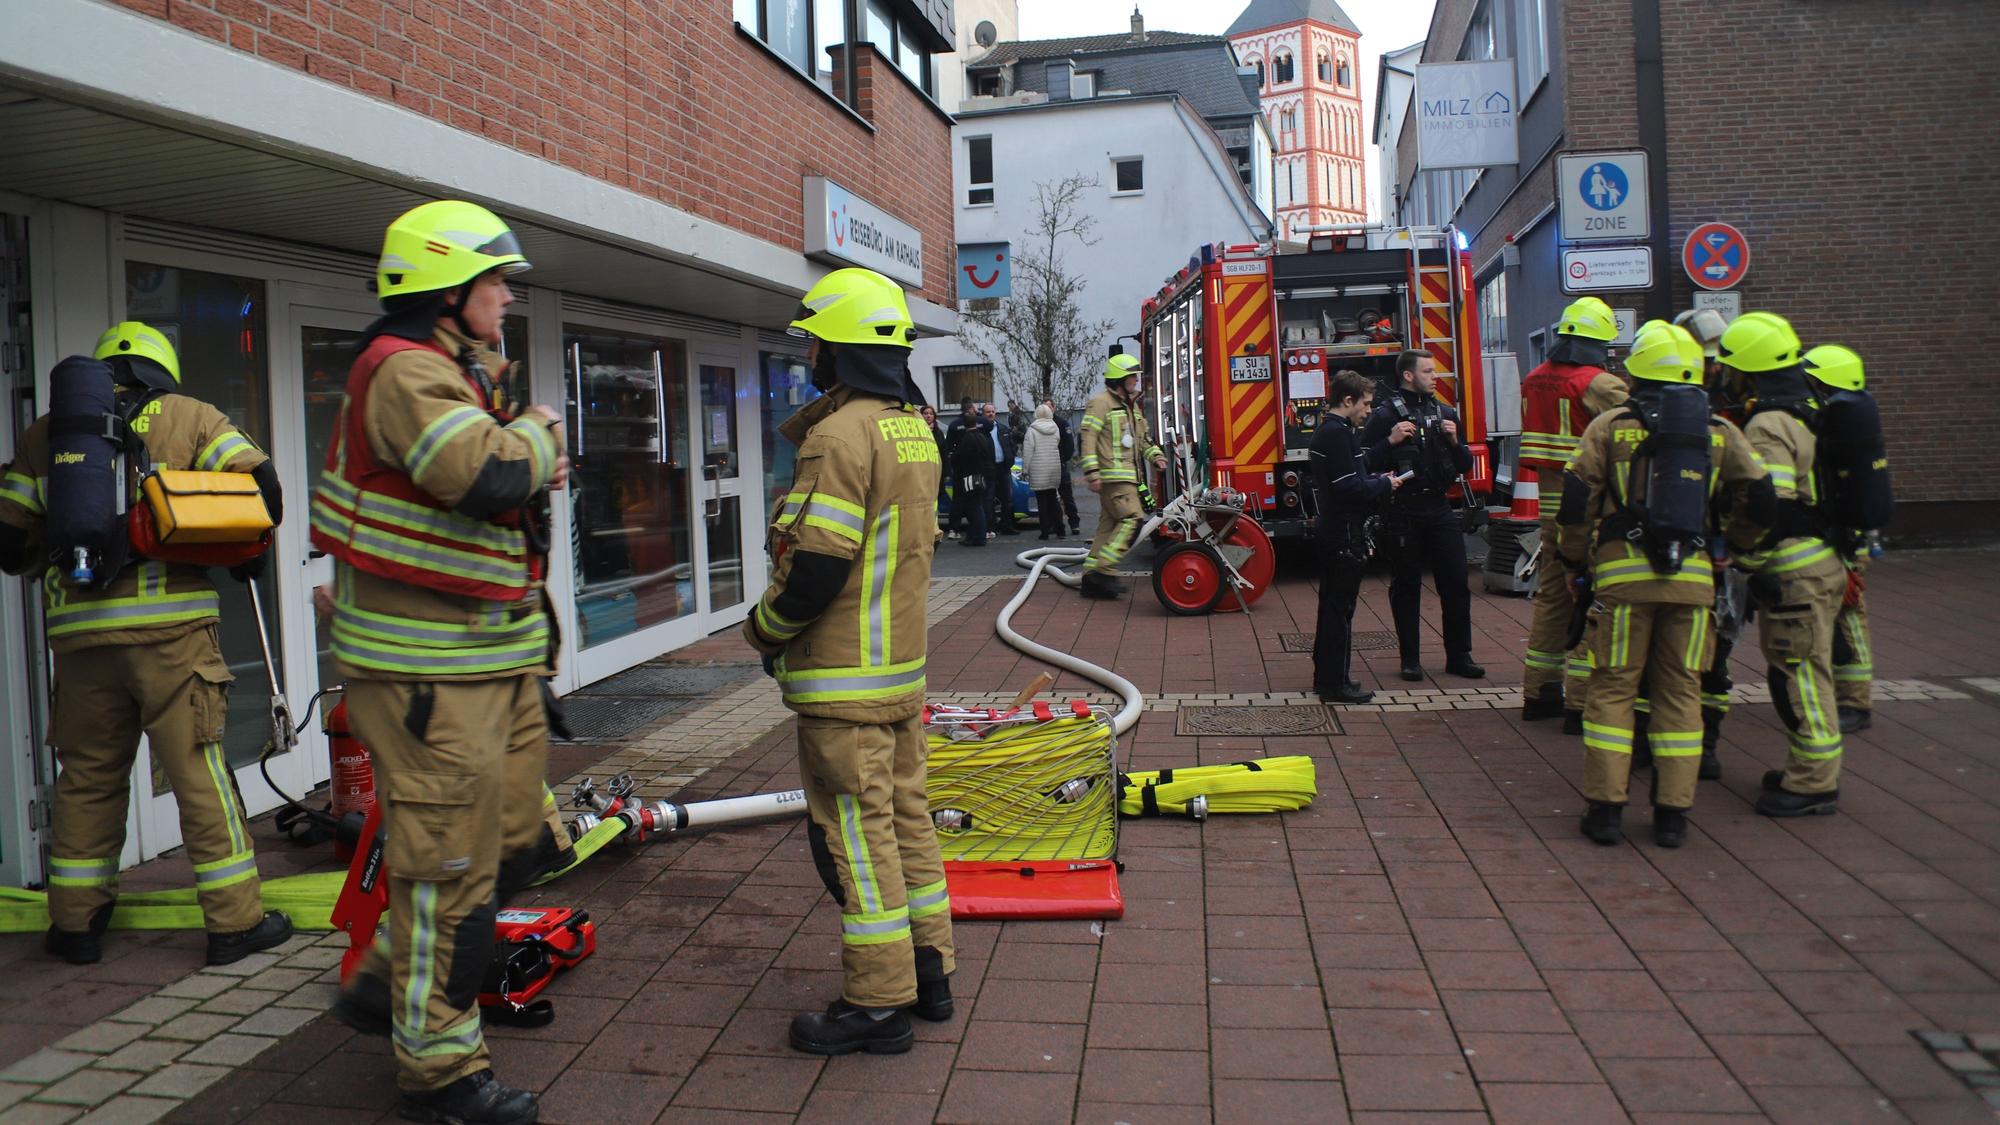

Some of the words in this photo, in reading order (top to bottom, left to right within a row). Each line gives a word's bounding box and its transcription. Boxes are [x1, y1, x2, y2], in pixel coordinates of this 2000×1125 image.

[1424, 99, 1470, 117] MILZ
[1424, 118, 1511, 131] IMMOBILIEN
[1584, 216, 1627, 231] ZONE
[849, 216, 883, 254] REISEBÜRO
[885, 235, 895, 259] AM
[896, 240, 920, 270] RATHAUS
[1245, 358, 1257, 369] SU
[1233, 369, 1245, 380] FW
[1247, 368, 1269, 379] 1431
[55, 451, 86, 464] Dräger
